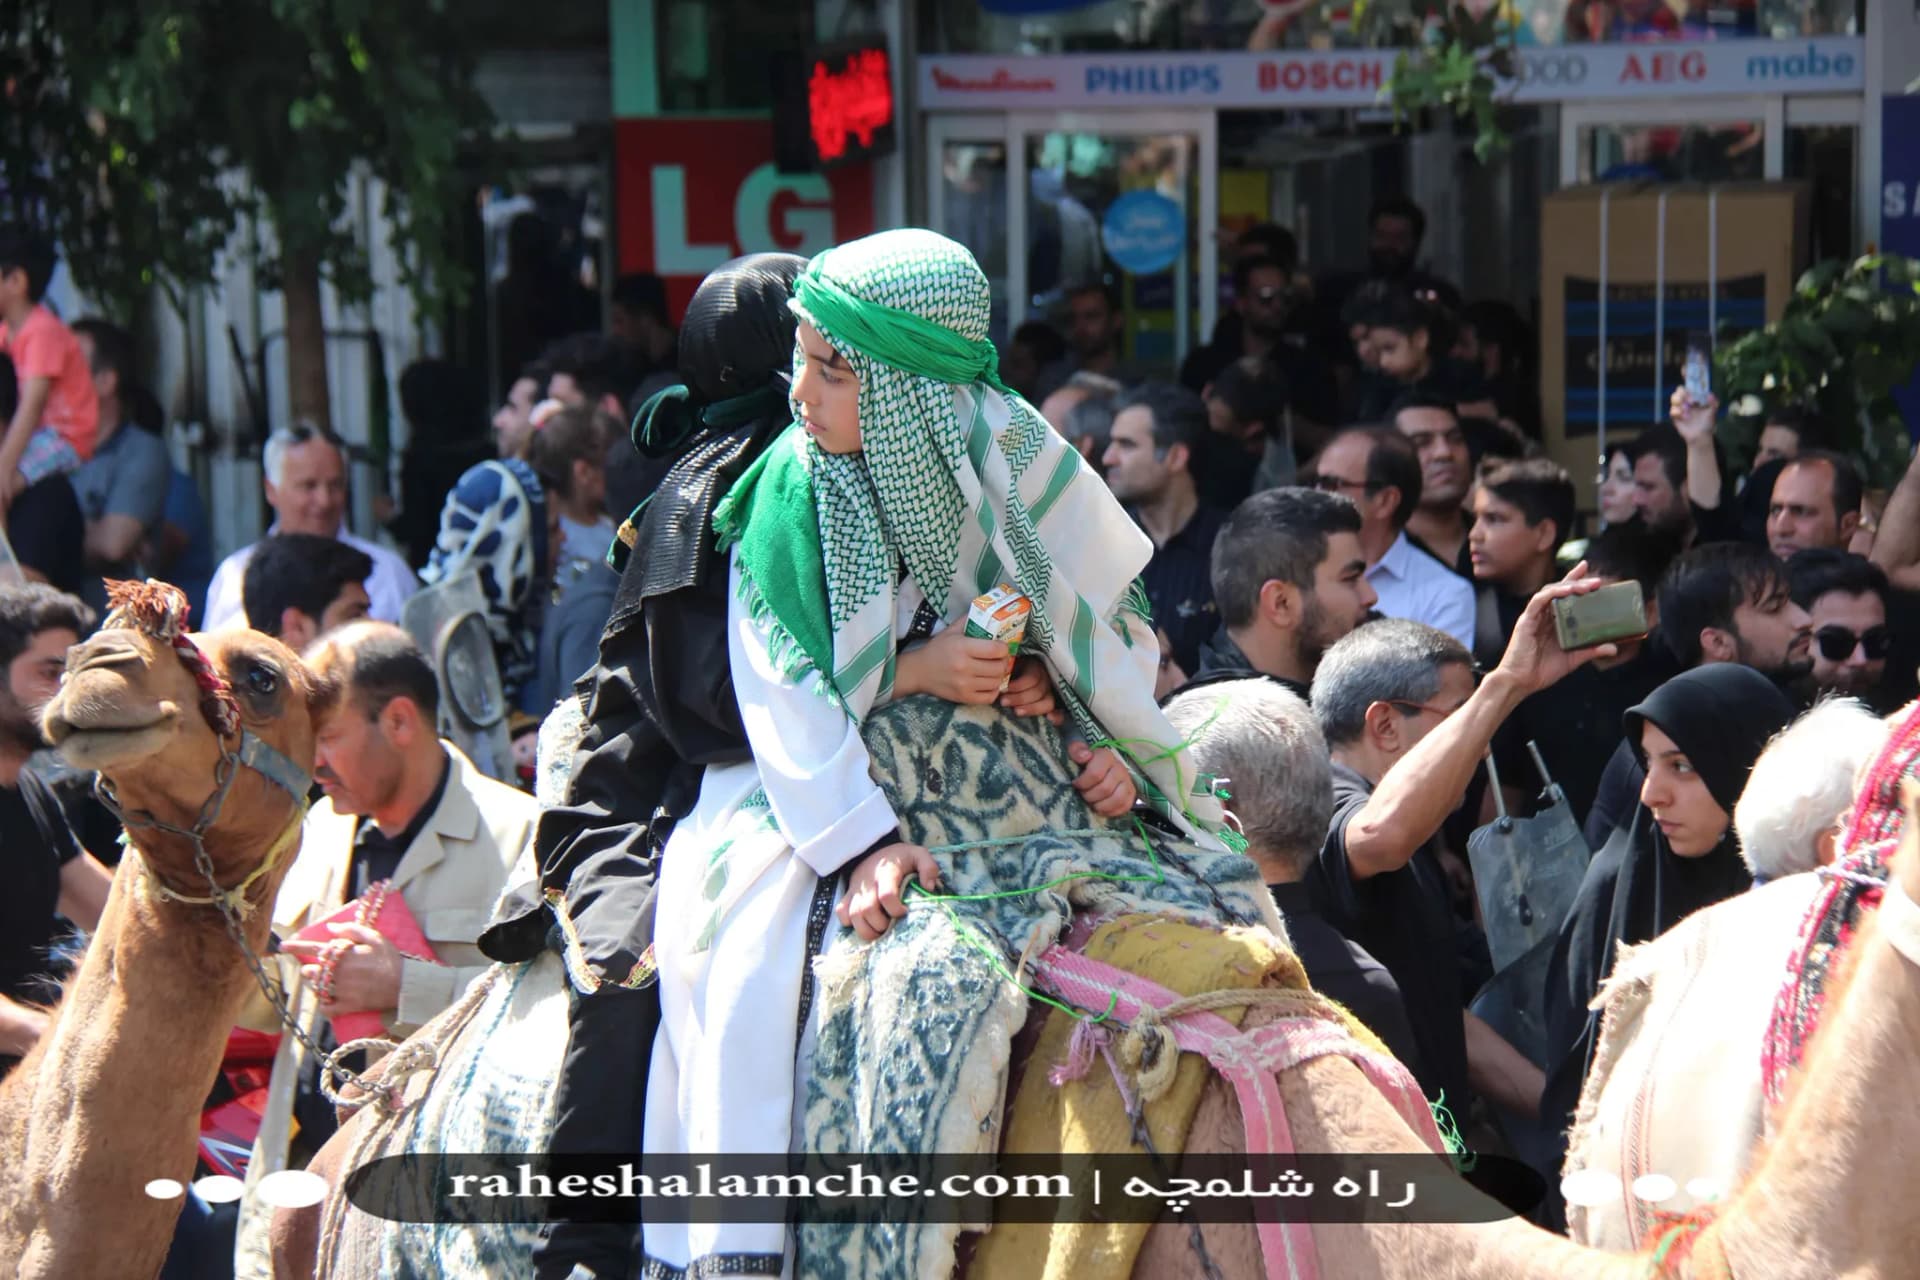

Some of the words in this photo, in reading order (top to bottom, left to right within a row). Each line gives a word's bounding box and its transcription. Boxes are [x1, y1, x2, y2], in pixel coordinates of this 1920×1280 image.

[1258, 60, 1382, 91] BOSCH
[1619, 50, 1707, 82] AEG
[1746, 45, 1855, 78] mabe
[1084, 65, 1222, 94] PHILIPS
[651, 162, 836, 276] LG
